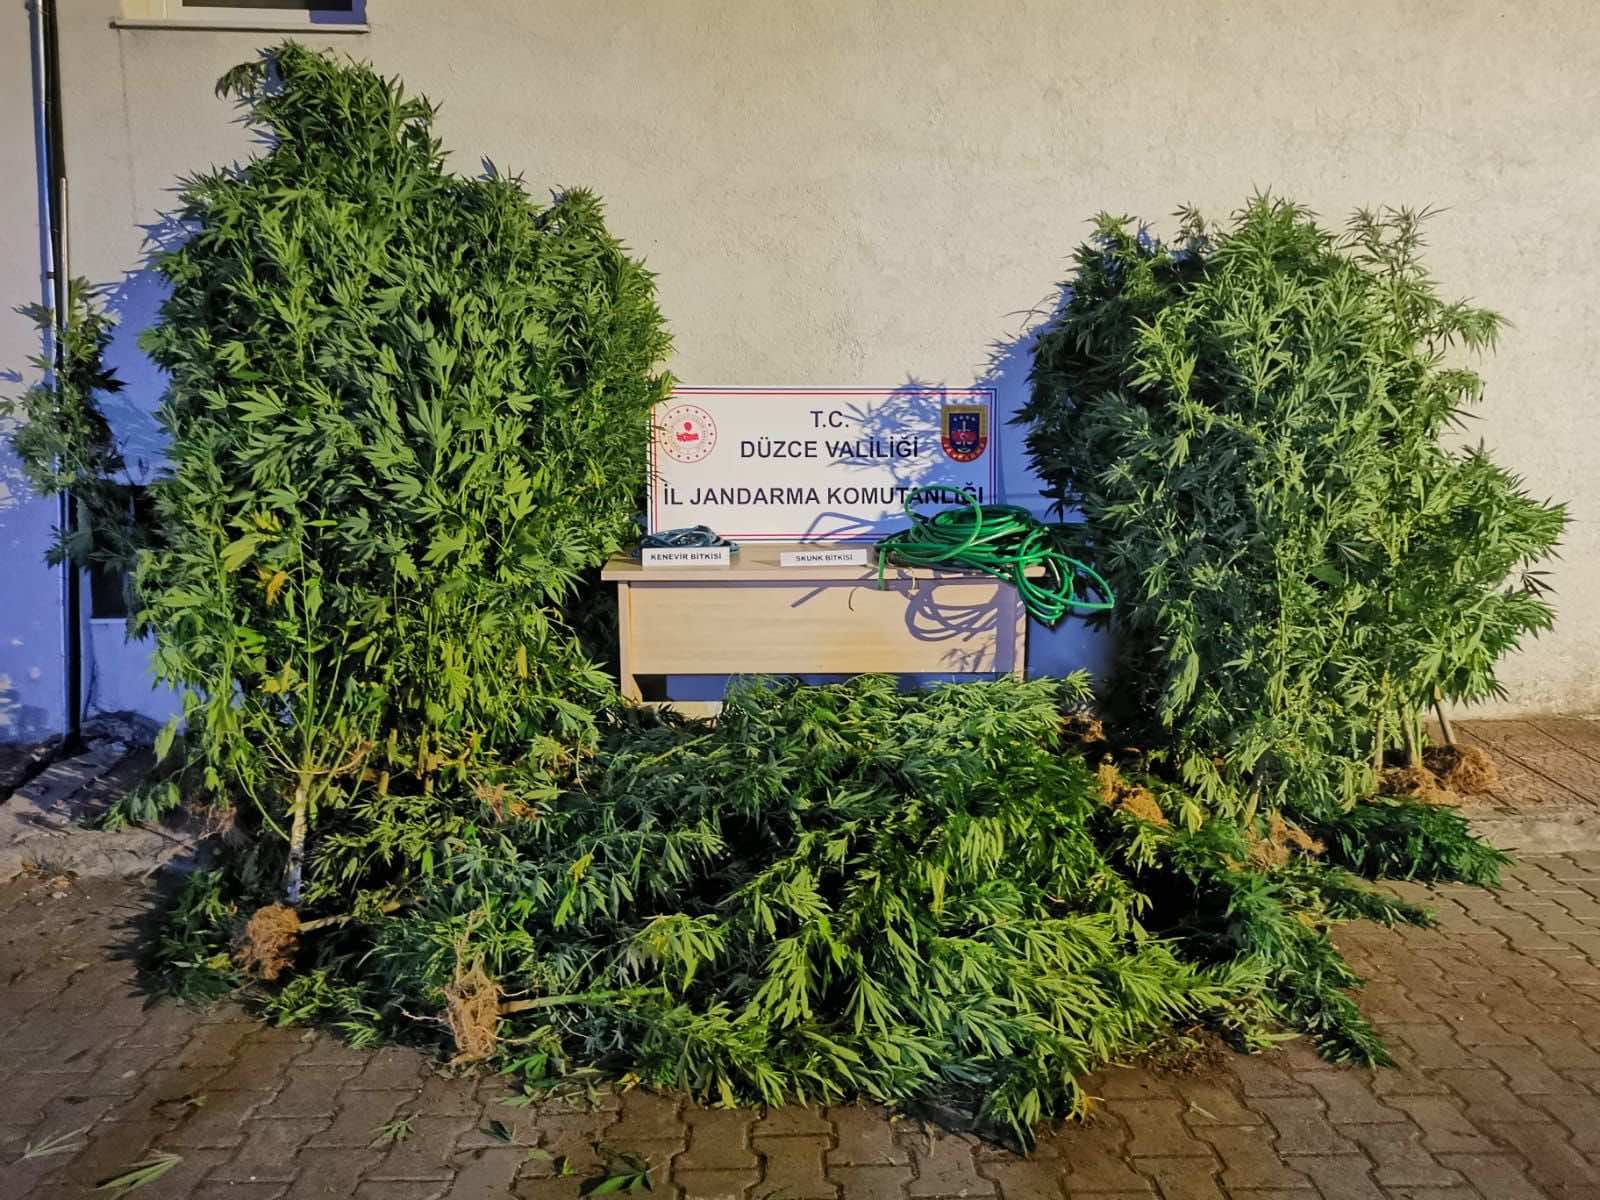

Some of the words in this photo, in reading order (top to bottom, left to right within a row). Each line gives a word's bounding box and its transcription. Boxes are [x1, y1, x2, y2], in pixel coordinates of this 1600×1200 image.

[810, 411, 849, 428] T.C.
[740, 437, 817, 458] DÜZCE
[827, 436, 919, 458] VALİLİĞİ
[664, 483, 683, 505] İL
[690, 487, 821, 505] JANDARMA
[828, 482, 984, 505] KOMUTANLIĞI
[650, 552, 688, 561] KENEVİR
[690, 551, 722, 560] BİTKİSİ
[795, 554, 823, 562] SKUNK
[825, 553, 853, 561] BİTKİSİ
